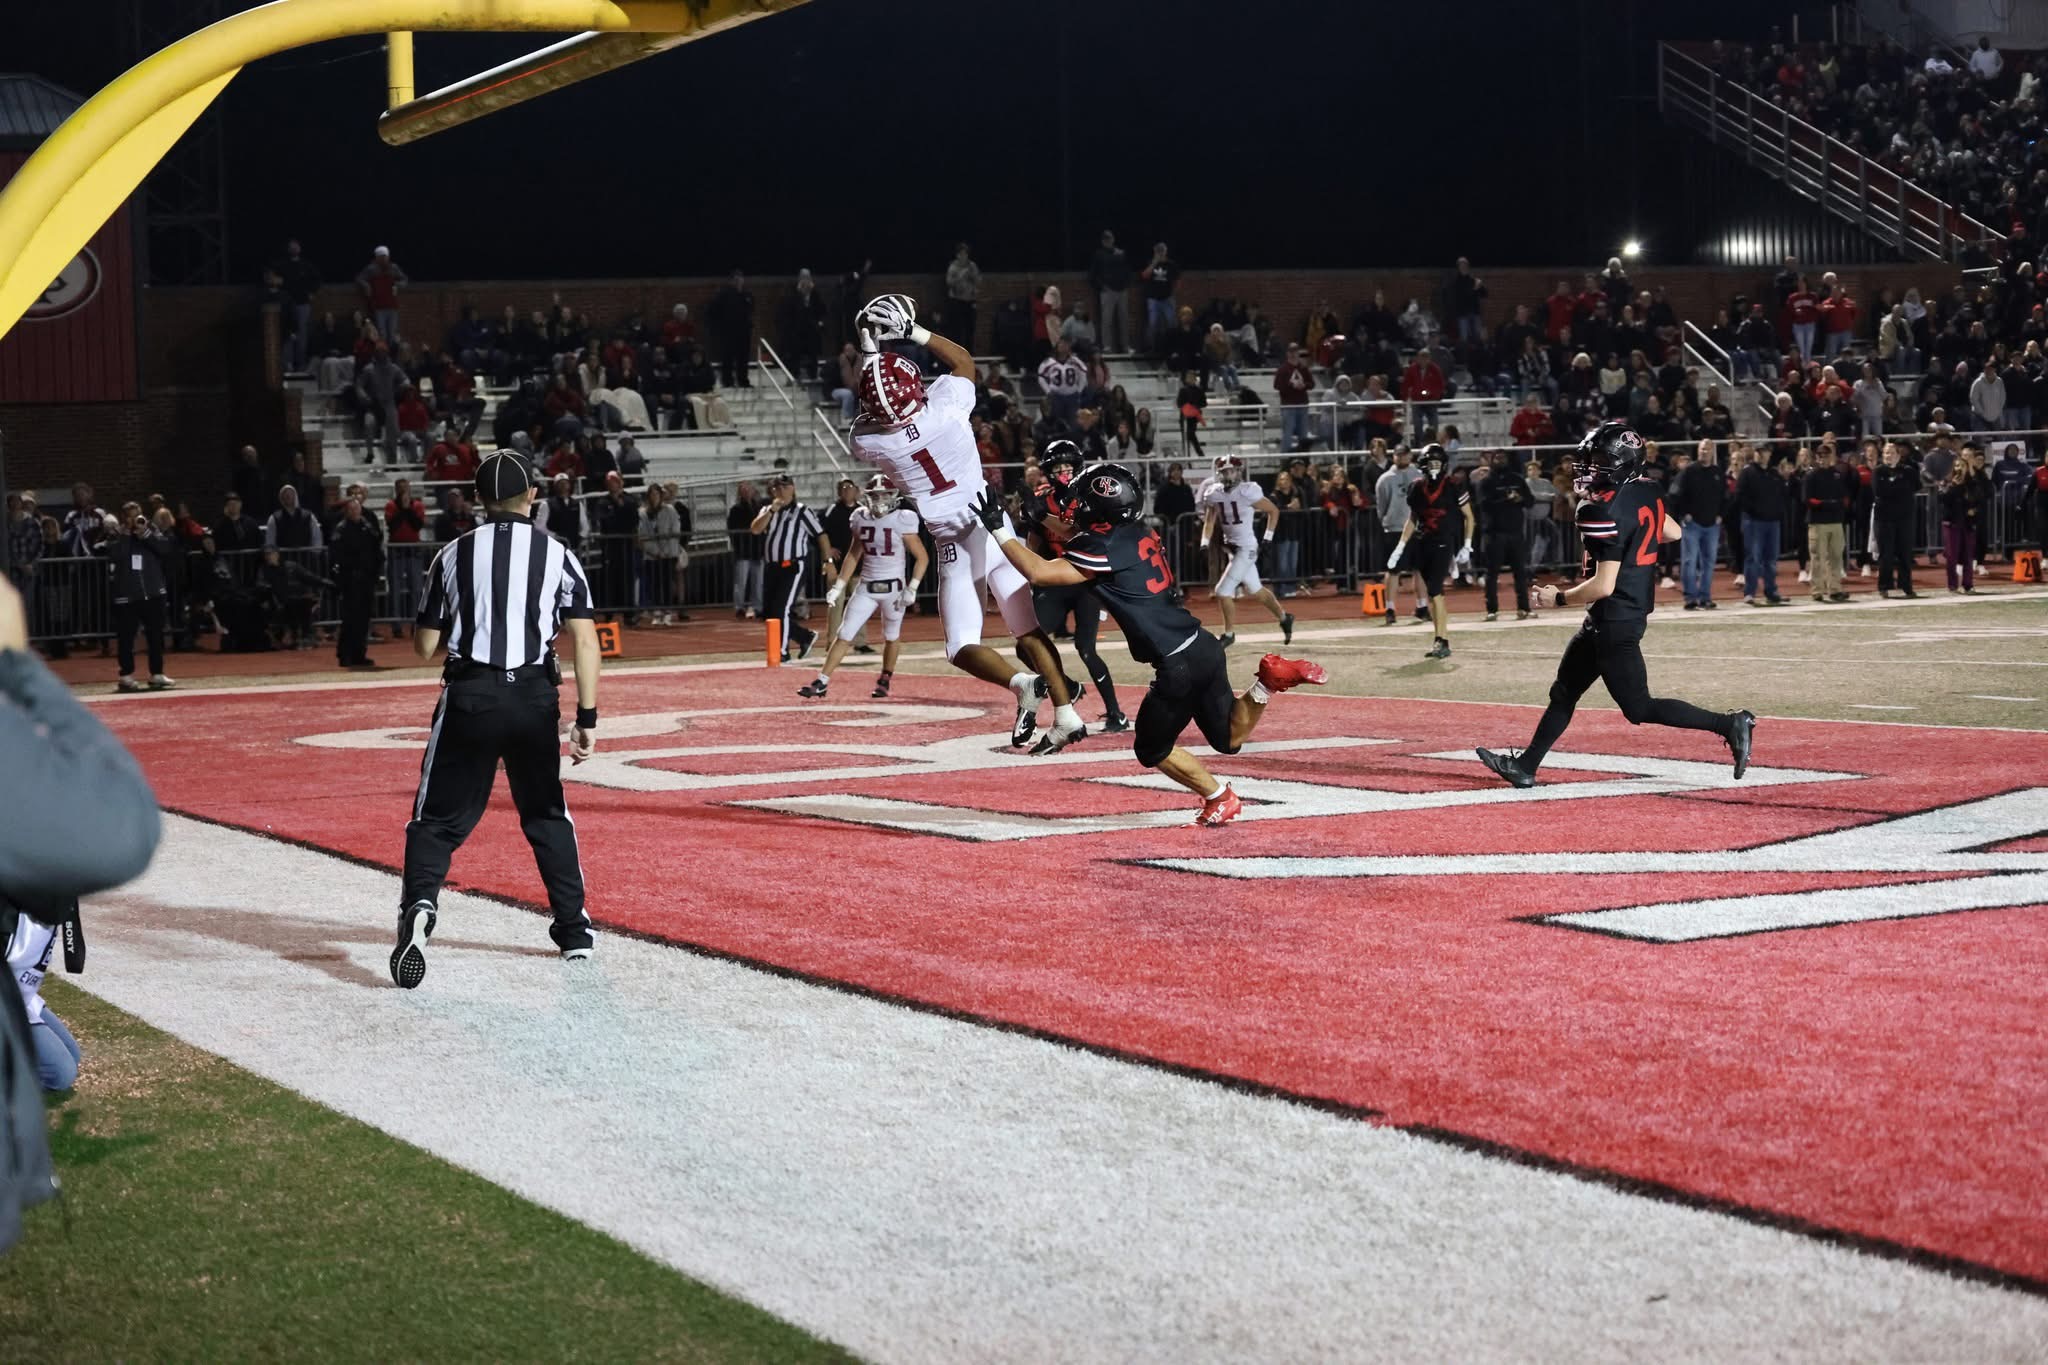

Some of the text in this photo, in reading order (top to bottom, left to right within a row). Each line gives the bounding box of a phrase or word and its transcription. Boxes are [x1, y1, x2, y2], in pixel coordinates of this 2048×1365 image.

[910, 448, 957, 496] 1
[1218, 501, 1243, 525] 11
[861, 526, 895, 556] 21
[1138, 527, 1174, 594] 3
[596, 627, 614, 652] G
[507, 672, 515, 682] S
[66, 921, 74, 953] SONY
